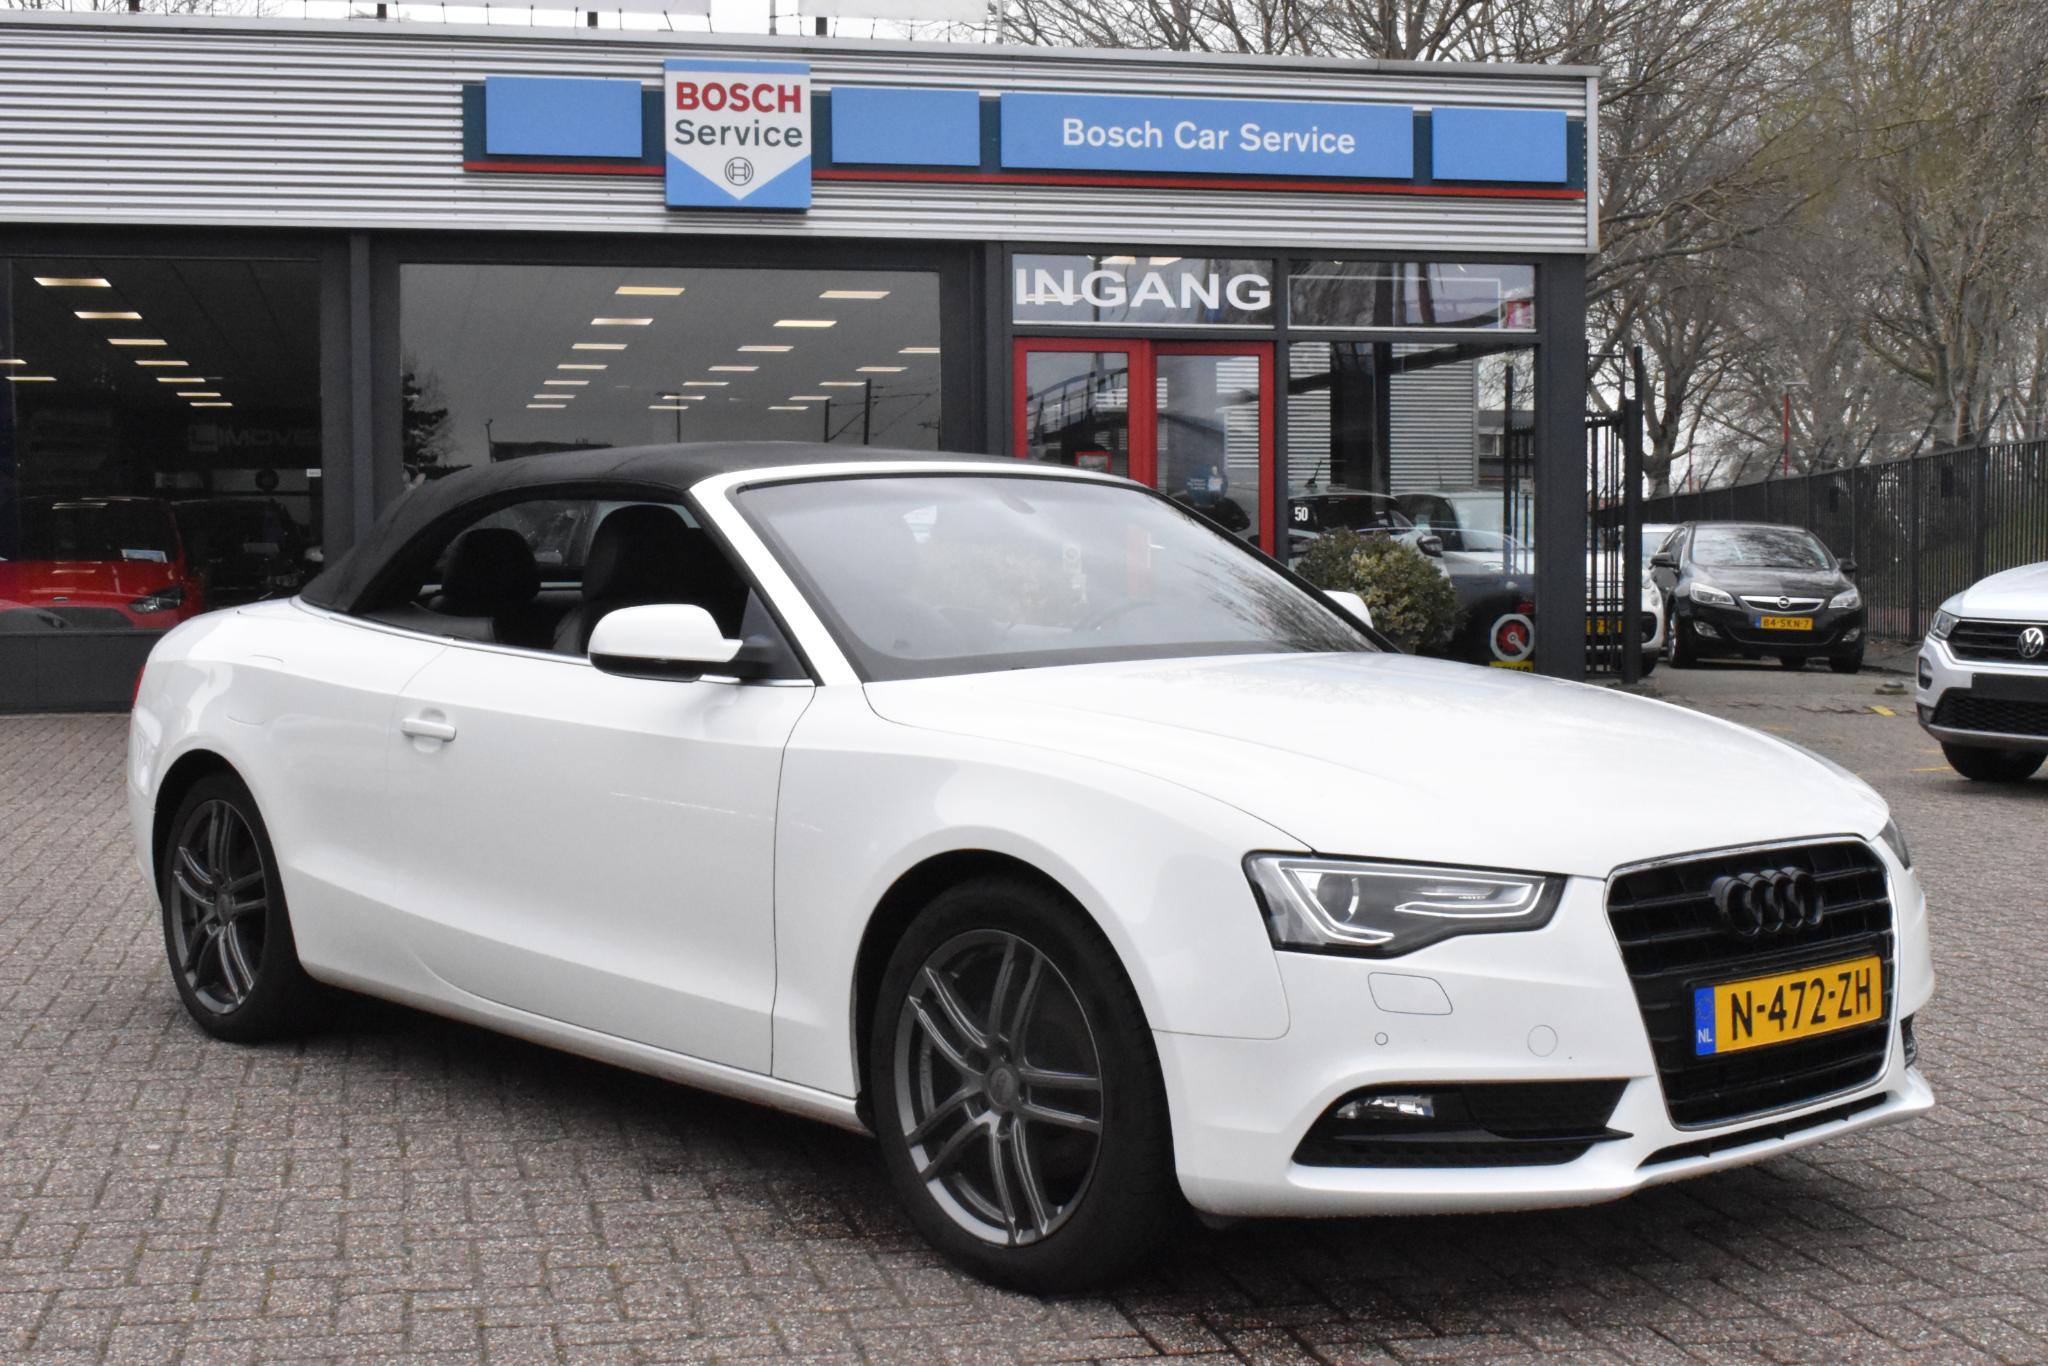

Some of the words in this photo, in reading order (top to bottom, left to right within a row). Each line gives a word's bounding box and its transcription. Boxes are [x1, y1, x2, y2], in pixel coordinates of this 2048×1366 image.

[676, 81, 802, 113] BOSCH
[674, 119, 804, 147] Service
[1063, 118, 1163, 148] Bosch
[1174, 121, 1229, 149] Car
[1239, 123, 1356, 154] Service
[1015, 268, 1271, 311] INGANG
[1294, 506, 1309, 522] 50
[1763, 617, 1810, 630] 84-SKN-7
[1731, 967, 1871, 1041] N-472-ZH
[1697, 1028, 1713, 1043] NL
